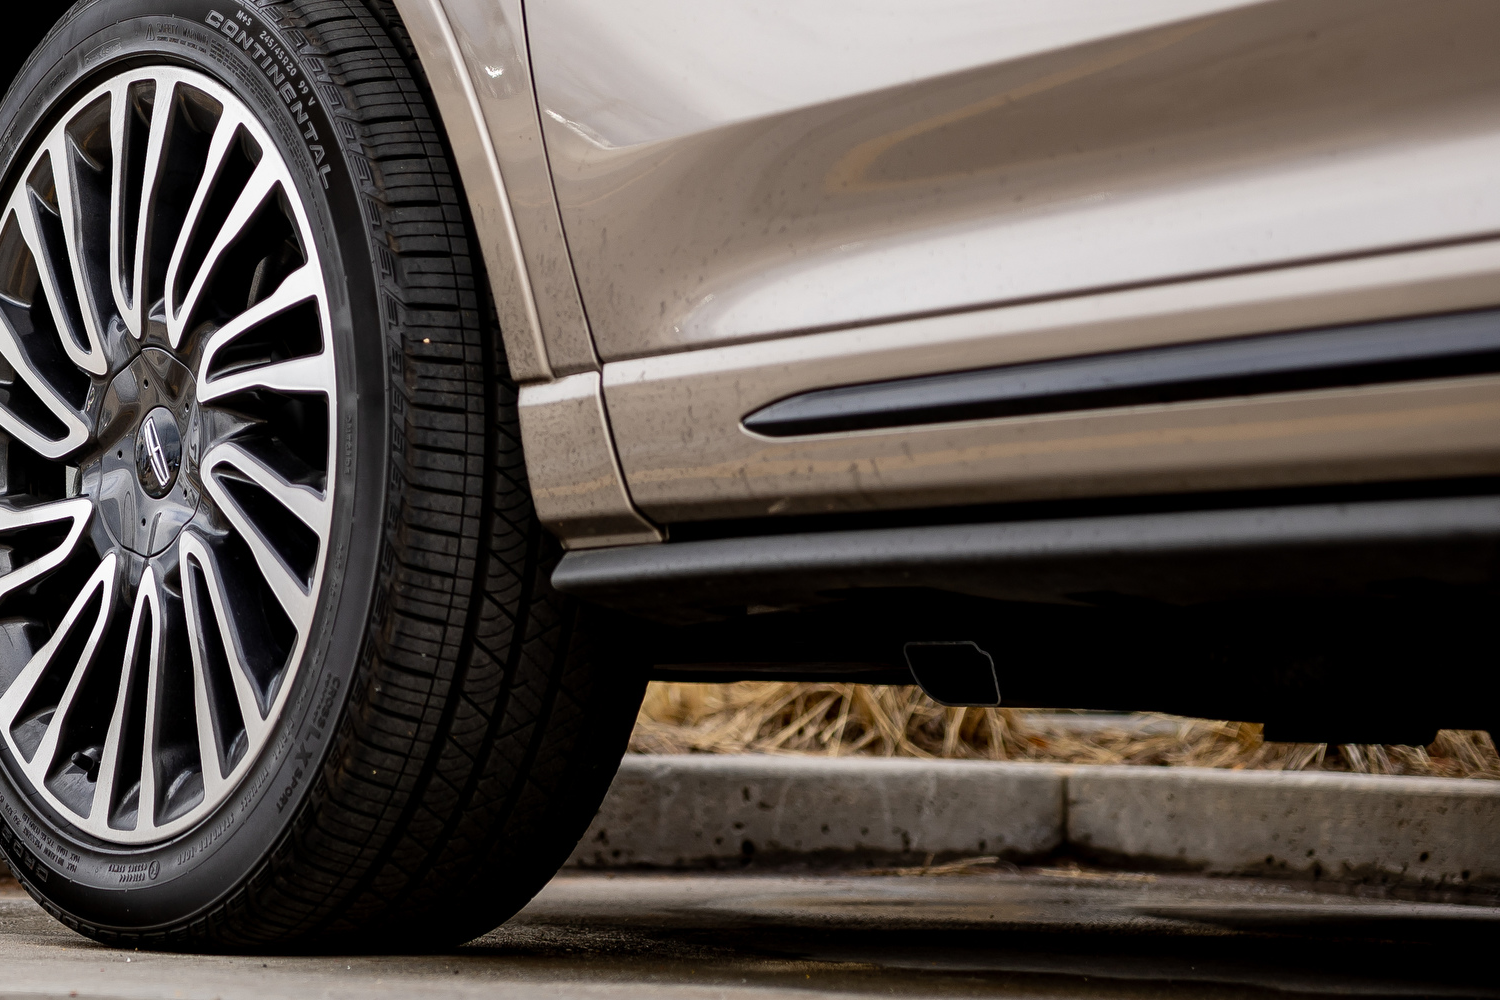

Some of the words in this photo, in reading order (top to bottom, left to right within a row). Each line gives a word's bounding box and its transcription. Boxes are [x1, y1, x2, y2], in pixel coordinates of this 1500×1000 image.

[236, 9, 252, 26] M+S
[297, 80, 308, 95] 99
[307, 96, 315, 106] V
[203, 8, 332, 190] CONTINENTAL
[317, 676, 341, 730] CROSS
[276, 767, 303, 814] SPORT
